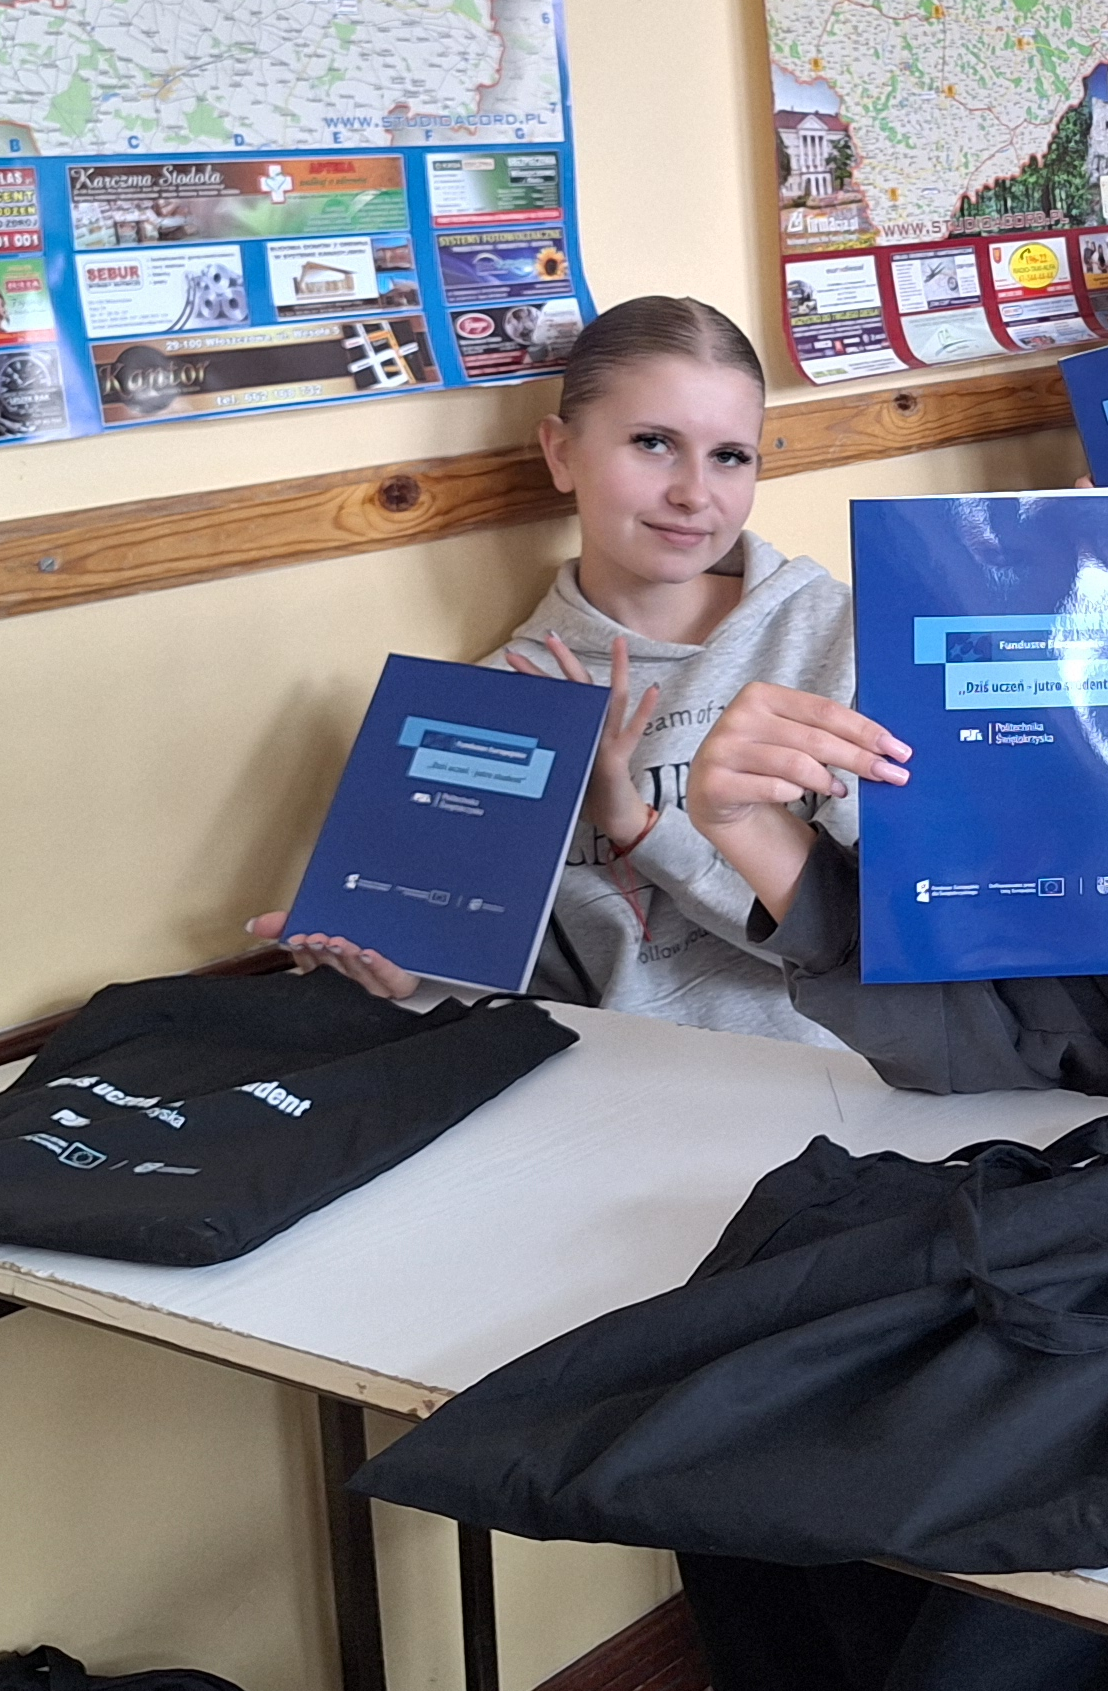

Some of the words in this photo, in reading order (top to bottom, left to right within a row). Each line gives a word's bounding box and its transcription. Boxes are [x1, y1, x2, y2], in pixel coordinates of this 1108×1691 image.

[541, 12, 551, 24] 6
[325, 113, 547, 129] WWW.STUDIOACORD.PL
[234, 134, 245, 147] D
[333, 131, 343, 145] E
[425, 129, 434, 142] F
[515, 127, 525, 140] G
[10, 138, 20, 152] B
[127, 136, 140, 150] C
[71, 166, 154, 190] Karczma
[882, 209, 1070, 238] WWW.STUDIOACORD.PL
[86, 265, 140, 282] SEBUR
[99, 359, 211, 397] Kantor
[999, 640, 1046, 650] Fundusze
[992, 679, 1025, 692] uczeń
[1033, 679, 1062, 695] jutro
[697, 699, 715, 725] of
[995, 722, 1044, 732] Politechnika
[995, 732, 1054, 746] Świętokrzyska
